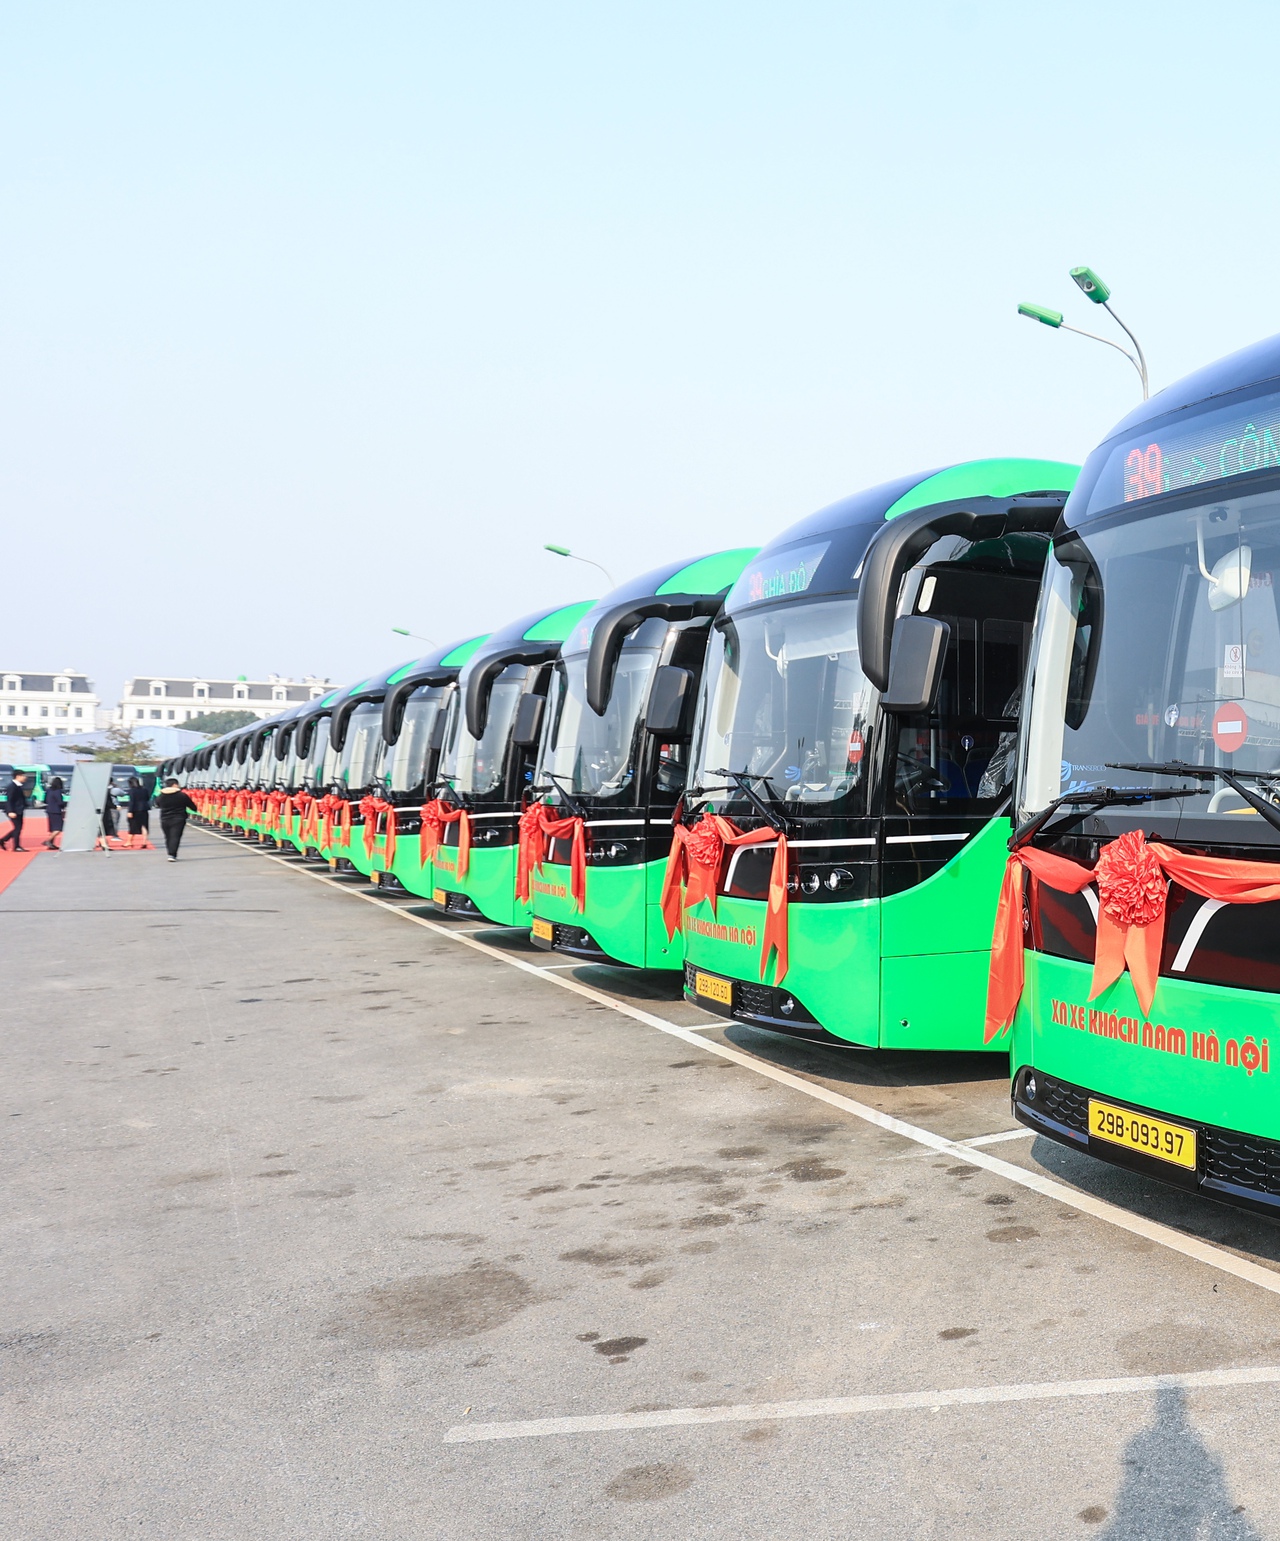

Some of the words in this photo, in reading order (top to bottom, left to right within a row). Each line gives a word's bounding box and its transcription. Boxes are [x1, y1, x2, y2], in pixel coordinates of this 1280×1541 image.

[1126, 443, 1163, 502] 39
[1069, 1002, 1086, 1031] XE
[1088, 1009, 1139, 1045] KHÁCH
[1141, 1021, 1187, 1056] NAM
[1192, 1029, 1219, 1063] HÀ
[1096, 1109, 1184, 1157] 29B-093.97
